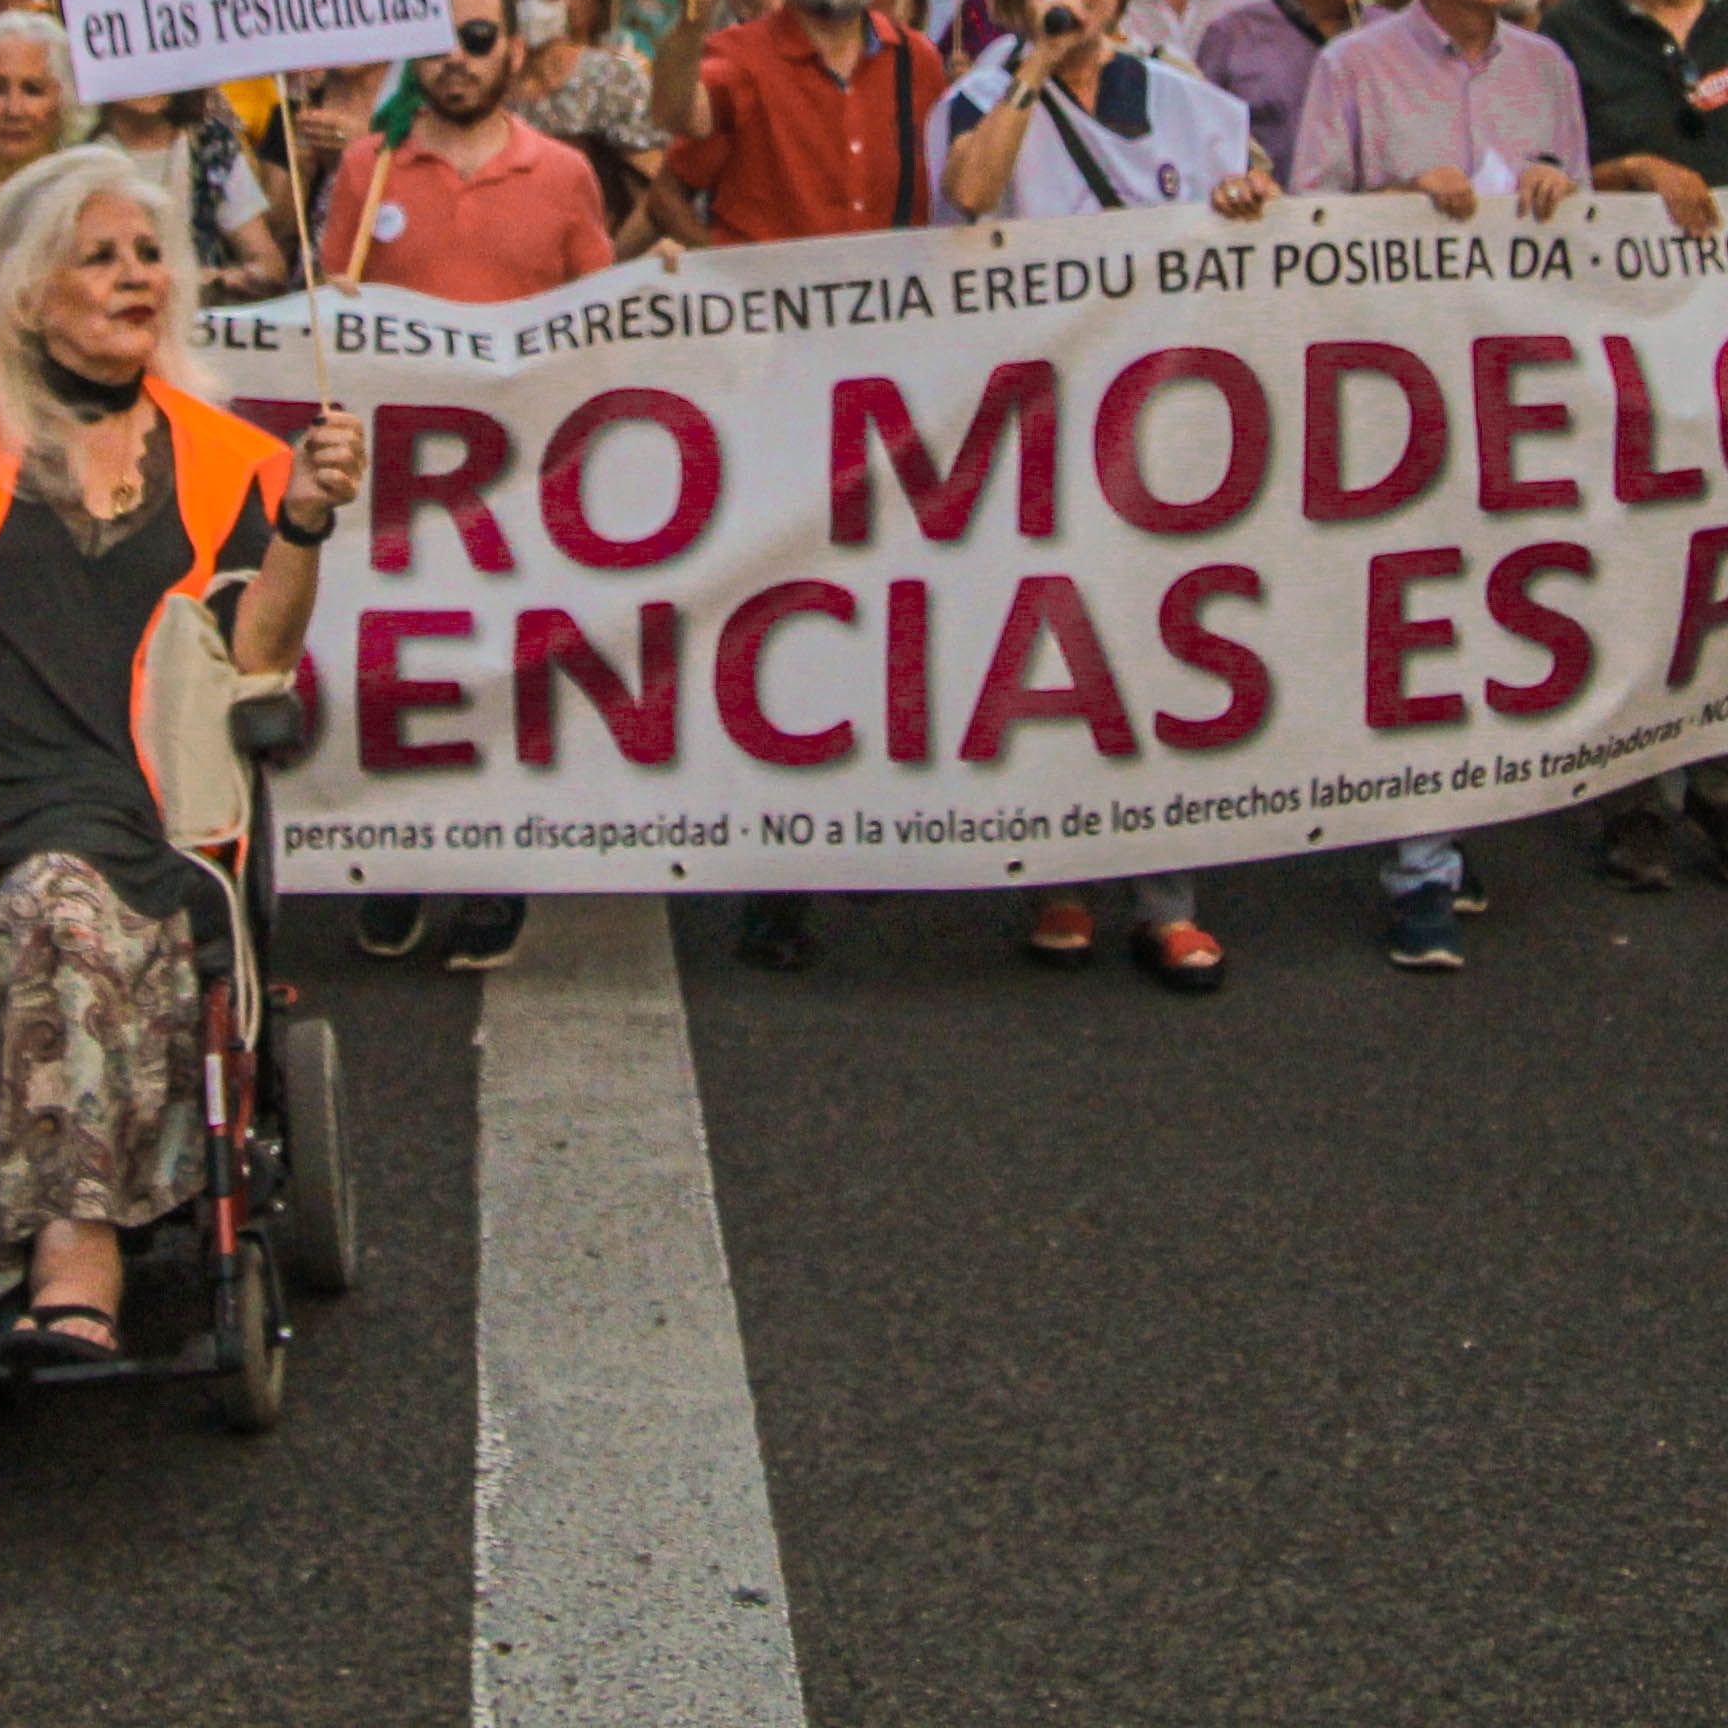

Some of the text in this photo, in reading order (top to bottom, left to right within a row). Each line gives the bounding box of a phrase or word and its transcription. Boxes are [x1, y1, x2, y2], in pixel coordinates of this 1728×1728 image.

[84, 8, 134, 63] en
[335, 313, 496, 362] BESTE
[515, 276, 934, 359] ERRESIDENTZIA
[952, 253, 1137, 316] EREDU
[1159, 245, 1256, 294] BAT
[1275, 235, 1491, 288] POSIBLEA
[1509, 236, 1574, 280] DA
[1364, 540, 1596, 731] ES
[284, 819, 435, 858] personas
[446, 820, 503, 849] con
[514, 813, 730, 858] discapacidad
[761, 813, 815, 846] NO
[826, 820, 847, 845] a
[856, 811, 885, 845] la
[895, 806, 1054, 845] violación
[1062, 802, 1102, 839] de
[1111, 801, 1155, 835] los
[1164, 786, 1302, 830] derechos
[1310, 766, 1443, 810] laborales
[1452, 759, 1489, 791] de
[1495, 751, 1533, 785] las
[1540, 717, 1687, 779] trabajadoras
